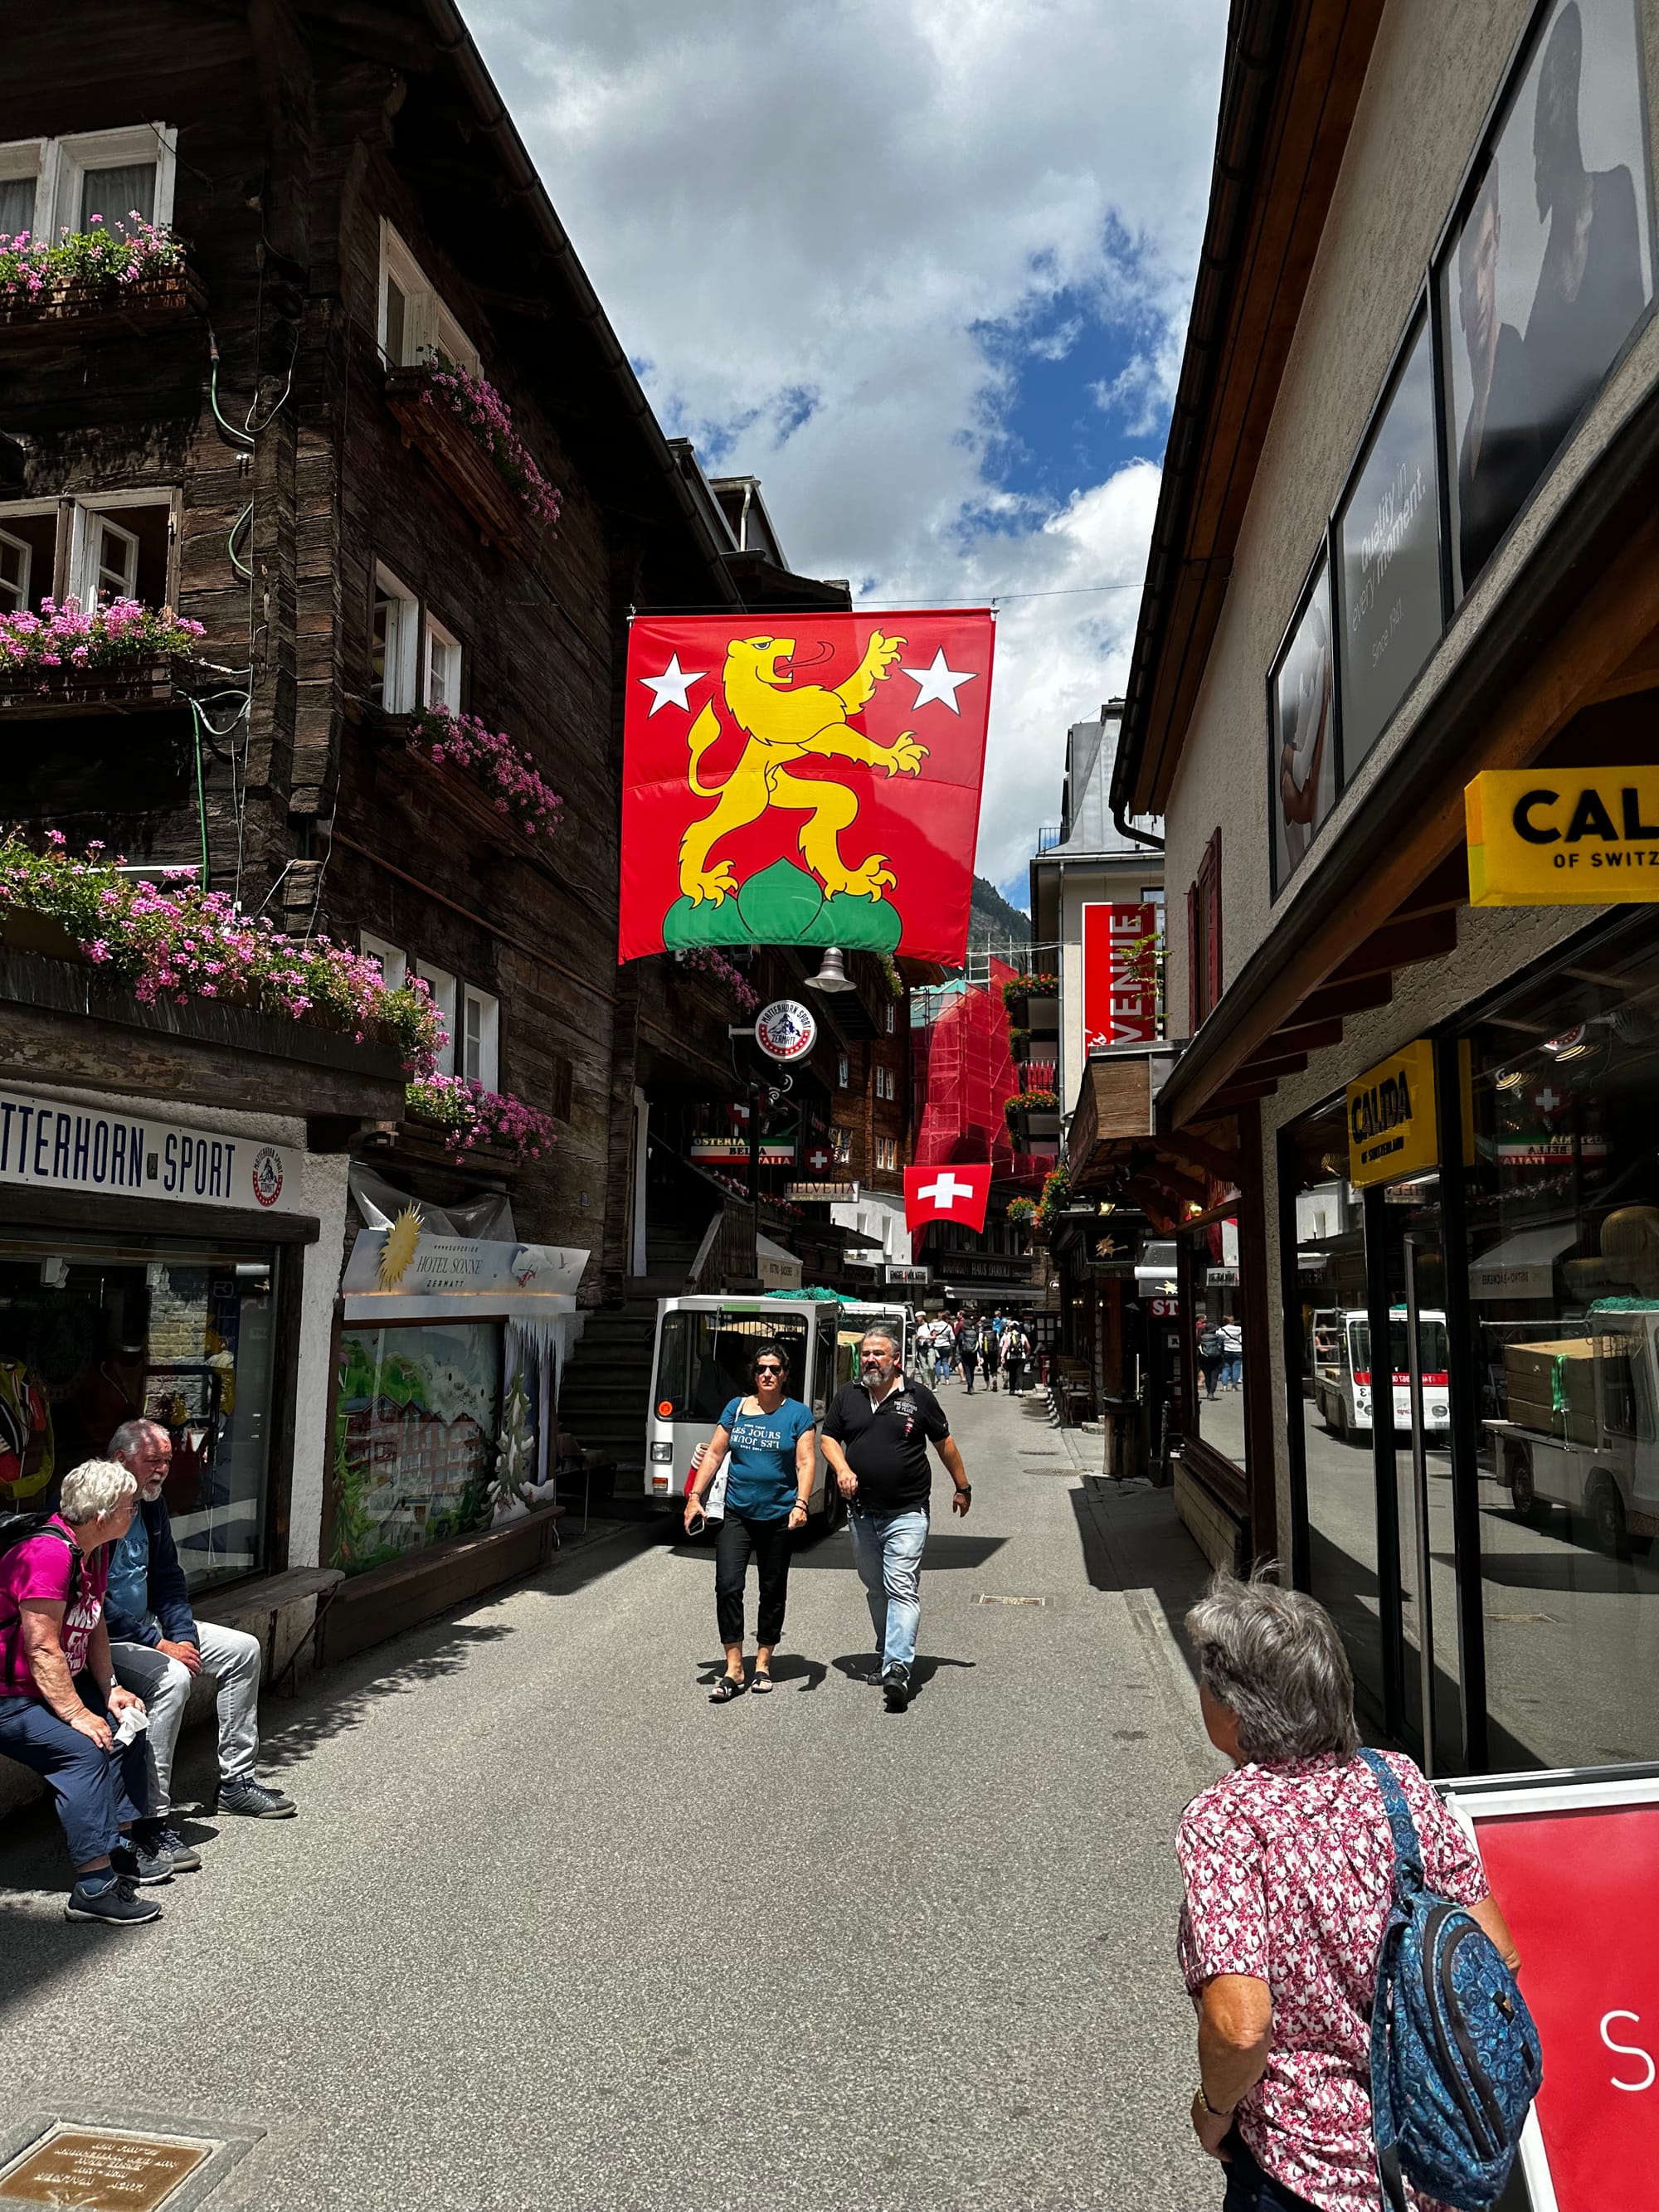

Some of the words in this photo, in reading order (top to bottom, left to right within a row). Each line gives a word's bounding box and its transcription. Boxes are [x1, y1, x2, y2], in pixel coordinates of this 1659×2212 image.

[1361, 481, 1395, 573] Quality
[1397, 463, 1407, 499] in
[1352, 568, 1375, 632] every
[1376, 466, 1426, 585] moment.
[1554, 853, 1579, 868] OF
[761, 1003, 799, 1024] MATTERHORN
[796, 1009, 811, 1028] SPORT
[771, 1033, 795, 1045] ZERMATT
[693, 1137, 746, 1146] OSTERIA
[728, 1147, 766, 1155] BELA
[163, 1133, 236, 1198] SPORT
[416, 1255, 447, 1273] HOTEL
[450, 1257, 483, 1275] SONNE
[426, 1280, 464, 1288] ZERMATT
[732, 1427, 746, 1435] LES
[748, 1428, 781, 1440] JOURS
[1600, 2010, 1655, 2092] S
